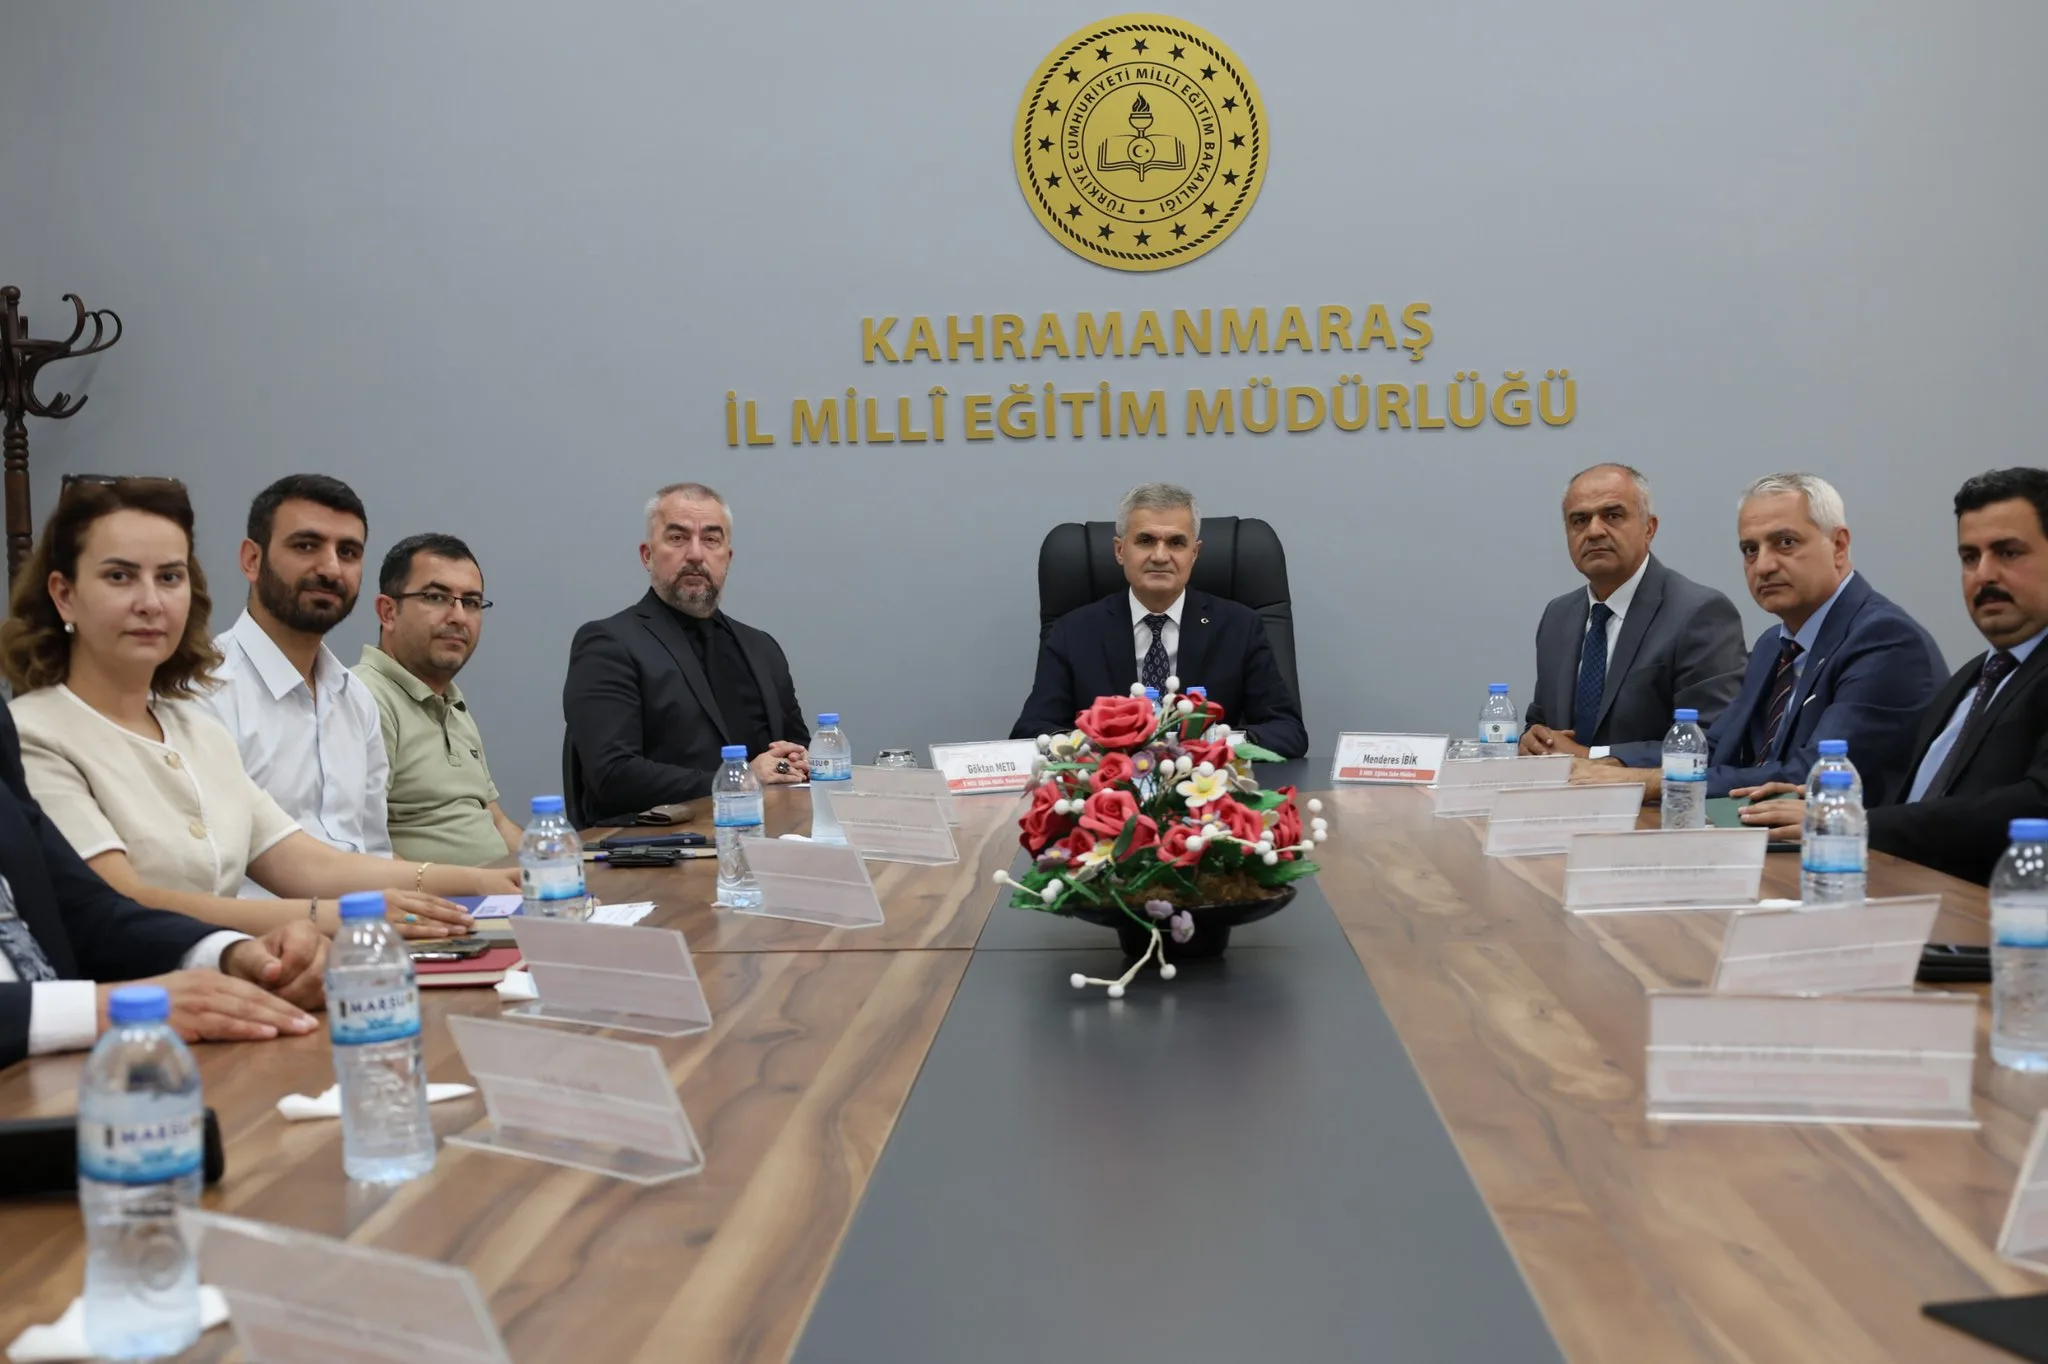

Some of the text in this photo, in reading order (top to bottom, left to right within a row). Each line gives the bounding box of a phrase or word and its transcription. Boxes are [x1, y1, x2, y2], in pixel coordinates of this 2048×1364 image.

[1068, 67, 1130, 159] CUMHURİYETİ
[1180, 84, 1215, 136] EĞİTİM
[1073, 164, 1126, 214] TÜRKİYE
[1159, 142, 1215, 213] BAKANLIĞI
[861, 302, 1434, 362] KAHRAMANMARAŞ
[726, 368, 1577, 446] İL MİLLÎ EĞİTİM MÜDÜRLÜĞÜ
[967, 763, 994, 774] Göktan
[1363, 752, 1418, 765] Menderes İBİK
